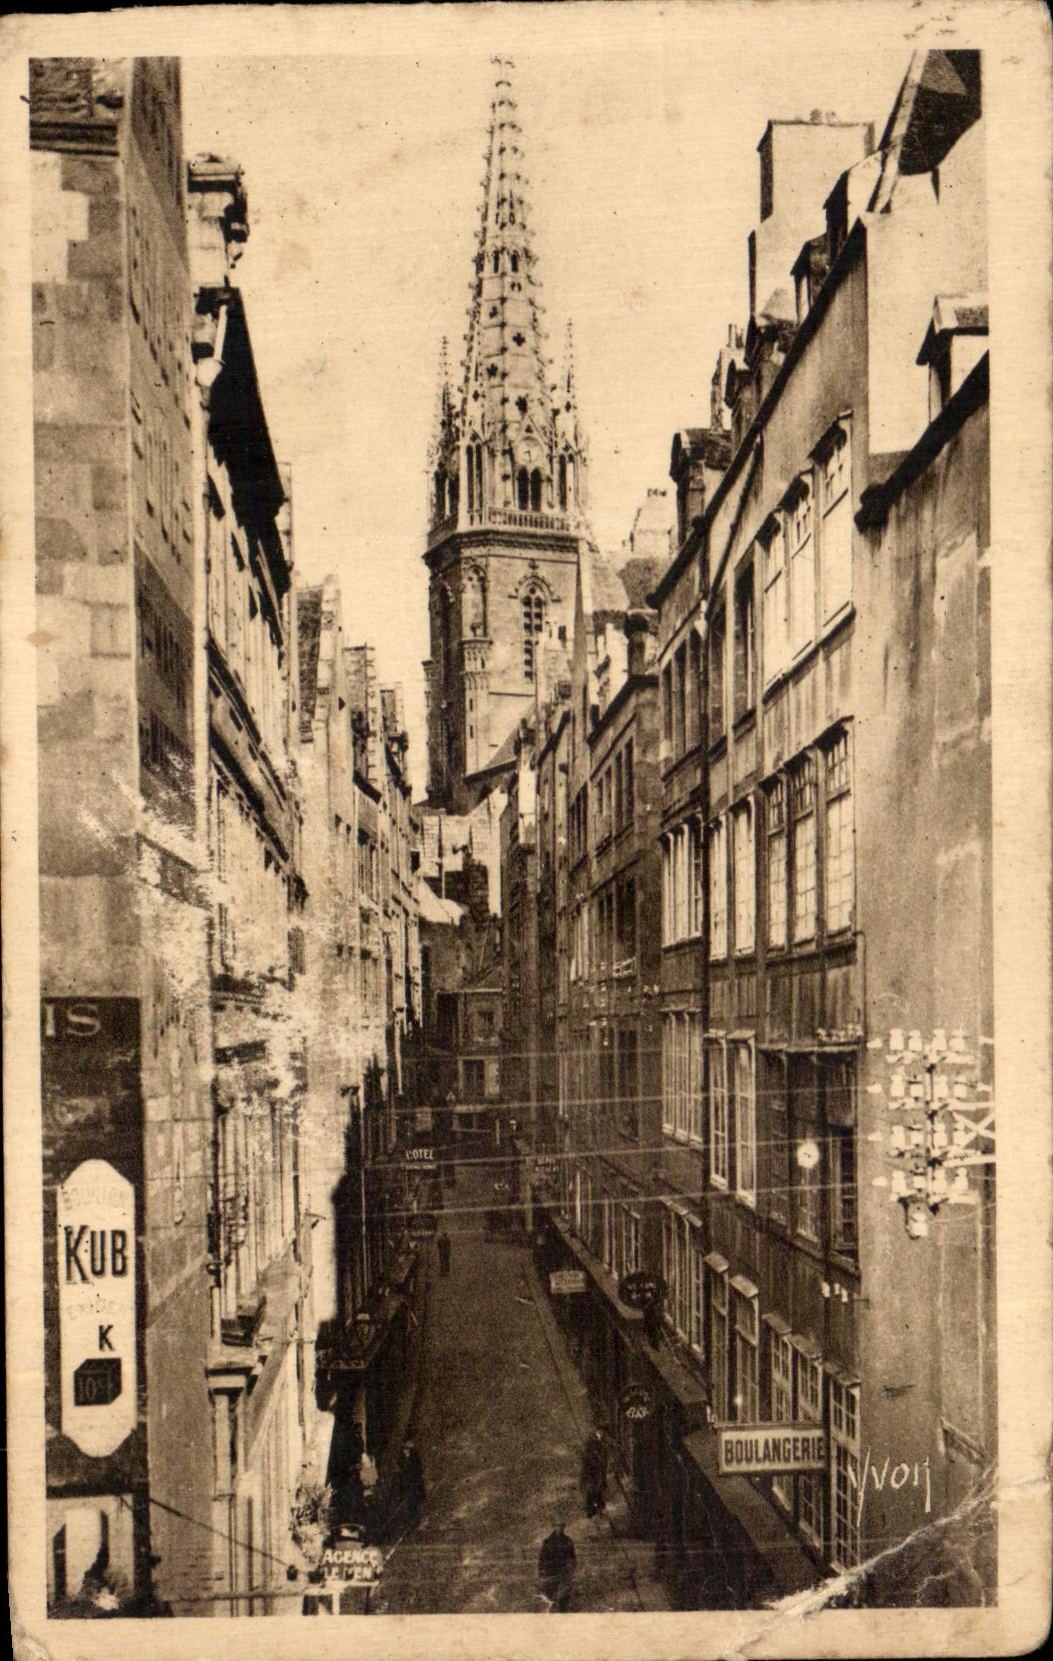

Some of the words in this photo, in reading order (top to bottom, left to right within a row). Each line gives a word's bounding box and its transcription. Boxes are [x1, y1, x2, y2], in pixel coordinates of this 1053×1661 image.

[64, 1225, 127, 1285] KUB
[98, 1325, 114, 1351] K
[724, 1437, 825, 1466] BOULANGERIE
[323, 1549, 378, 1564] AGENCE
